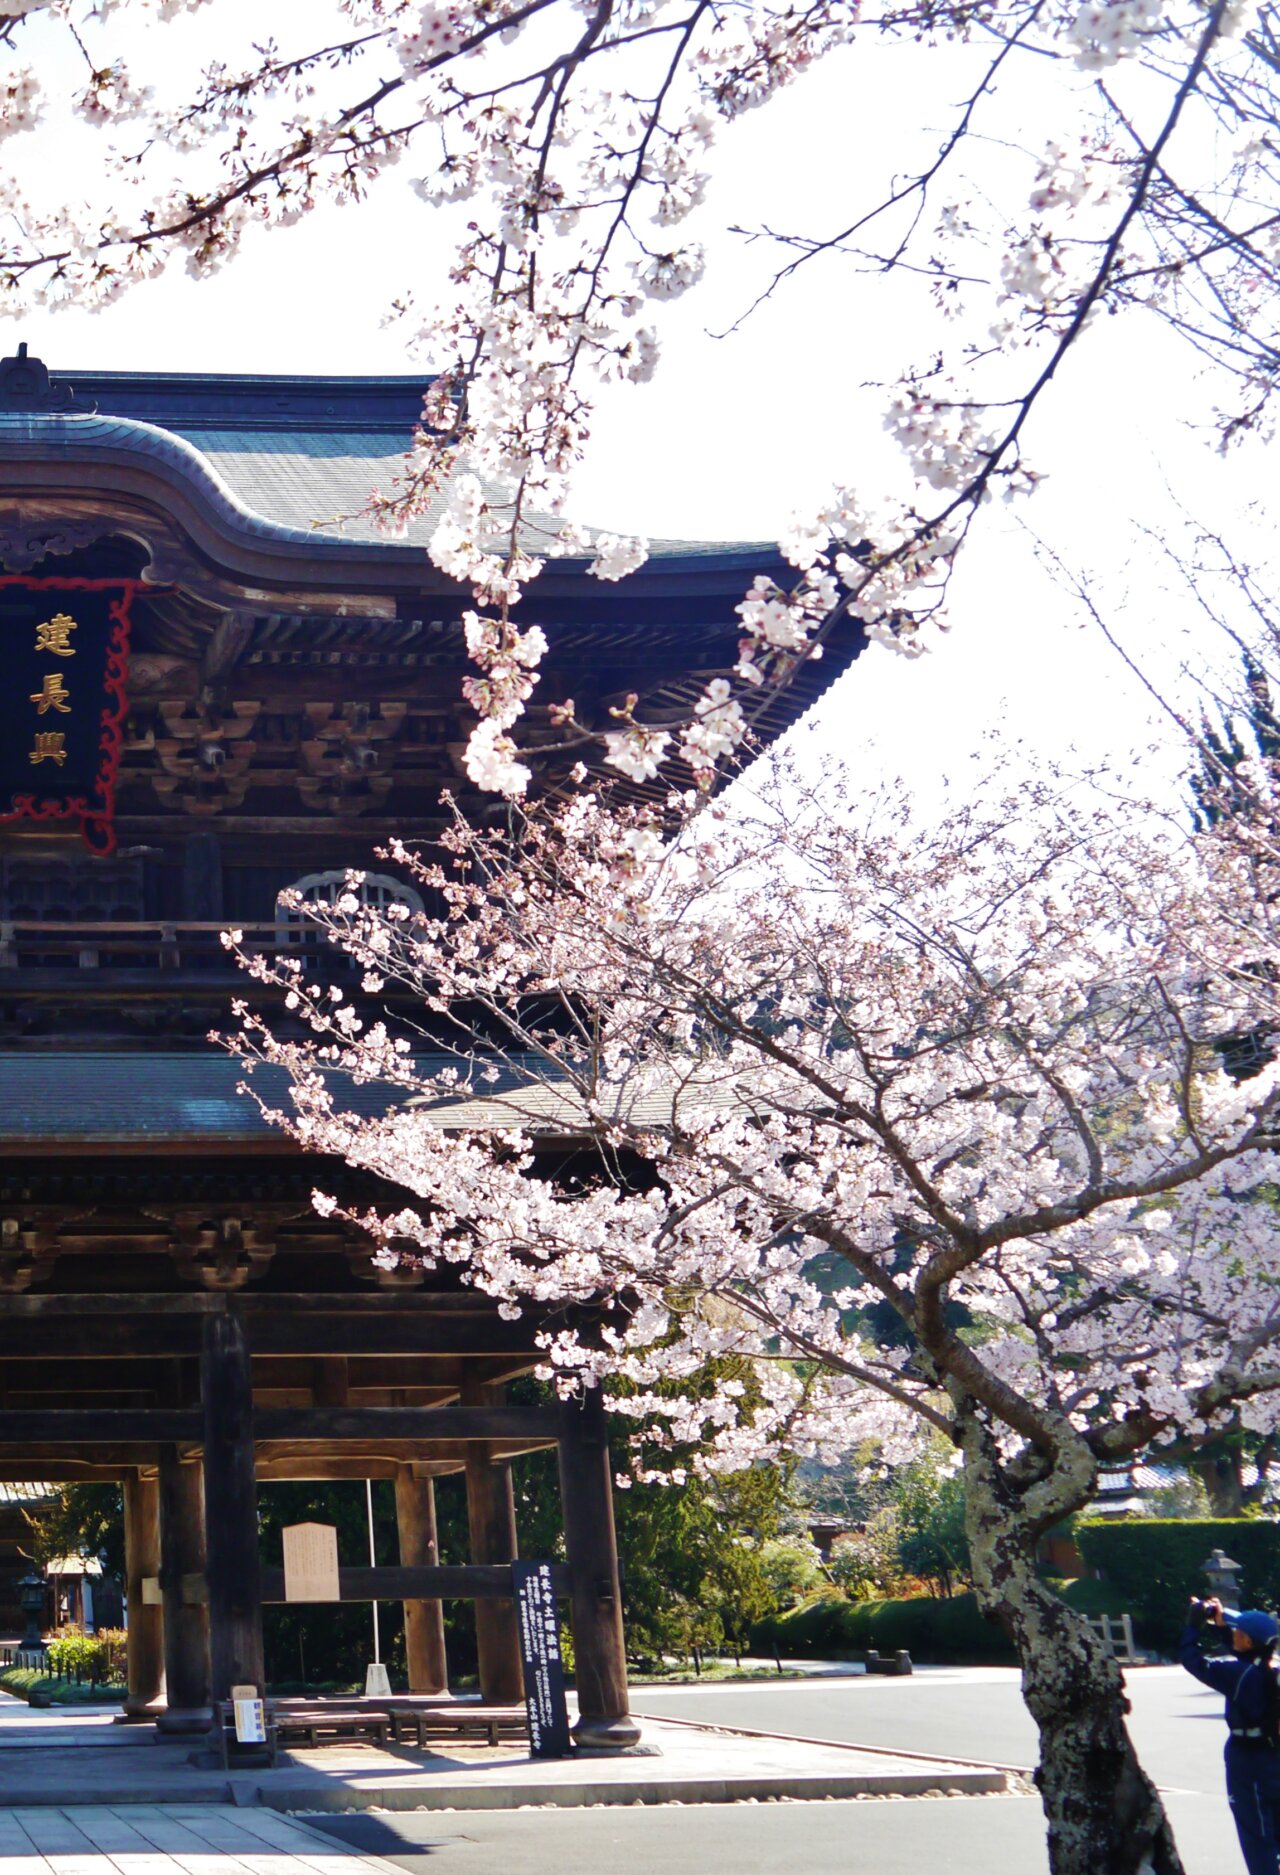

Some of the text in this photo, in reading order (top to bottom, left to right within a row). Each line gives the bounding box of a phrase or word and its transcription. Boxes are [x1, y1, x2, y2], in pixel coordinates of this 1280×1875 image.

[29, 613, 78, 767] 建長興
[539, 1565, 559, 1659] 建長寺土曜法話
[528, 1697, 538, 1720] 大本山
[530, 1721, 541, 1749] 建長寺
